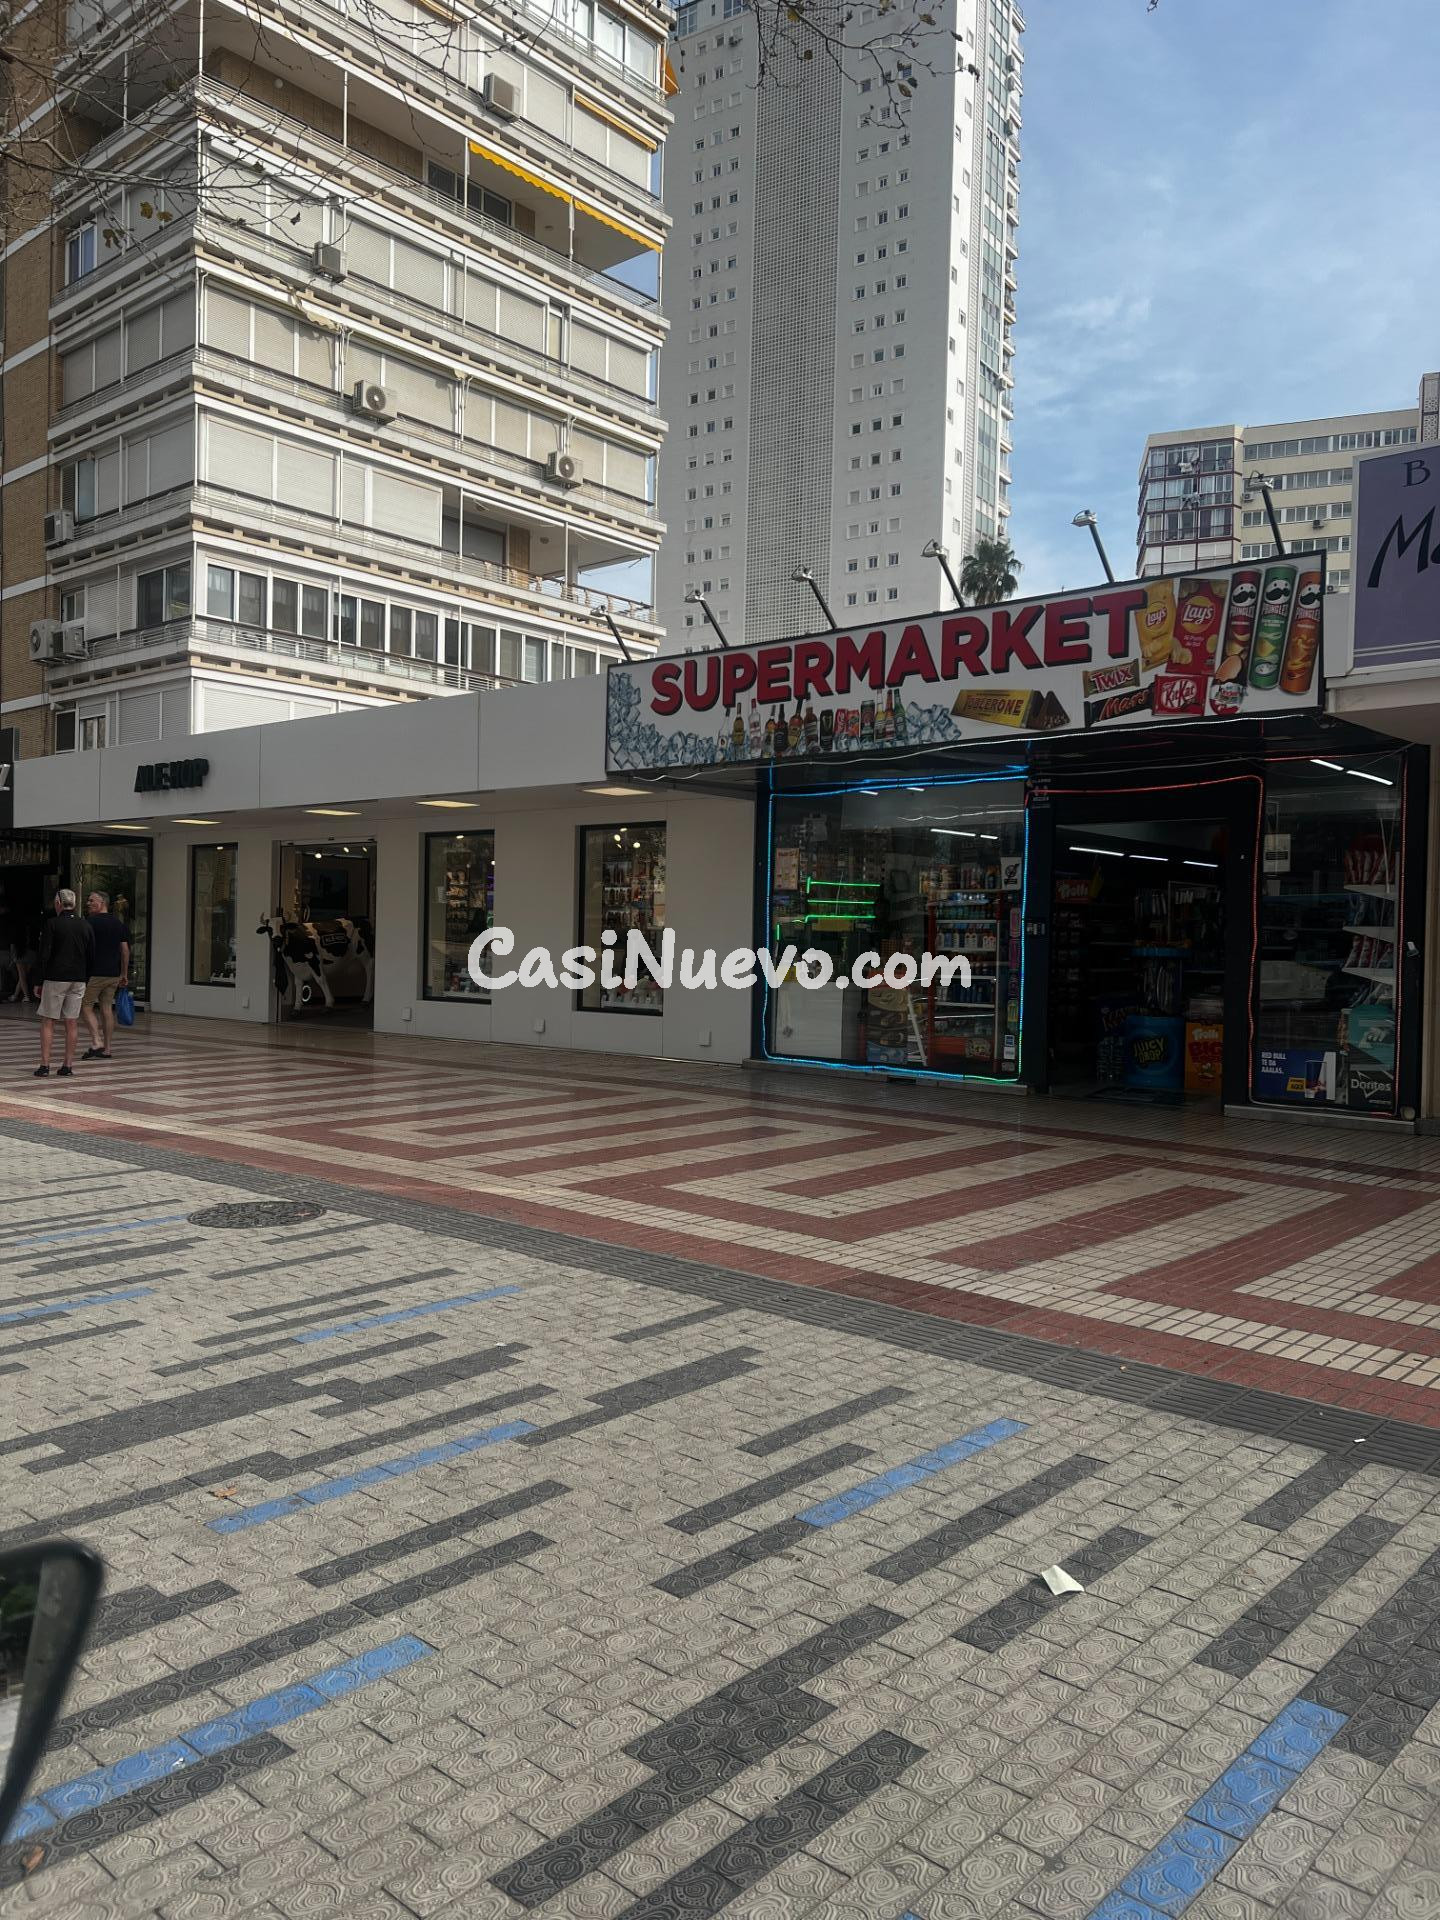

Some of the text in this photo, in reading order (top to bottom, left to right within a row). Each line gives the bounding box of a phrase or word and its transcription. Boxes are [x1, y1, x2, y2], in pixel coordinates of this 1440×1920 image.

[1402, 459, 1431, 487] B
[1146, 606, 1167, 628] Lay's
[1182, 603, 1214, 626] Lay's
[651, 588, 1147, 716] SUPERMARKET
[1351, 1078, 1391, 1091] Doritos
